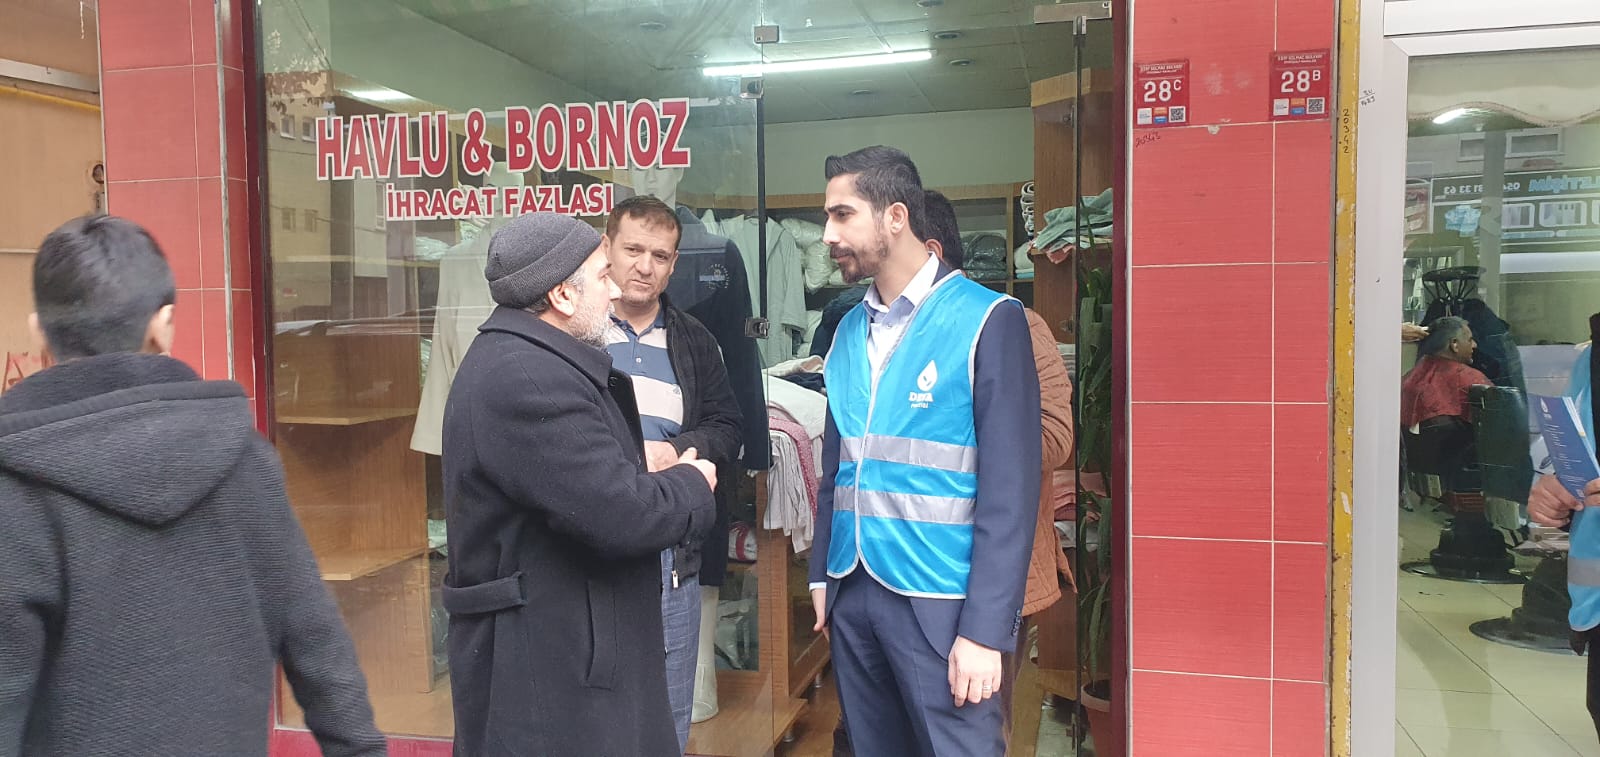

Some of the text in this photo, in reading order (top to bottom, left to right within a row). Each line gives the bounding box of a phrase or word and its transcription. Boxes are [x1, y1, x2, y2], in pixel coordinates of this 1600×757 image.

[316, 97, 691, 180] HAVLU & BORNOZ
[386, 183, 615, 221] İHRACAT FAZLASI
